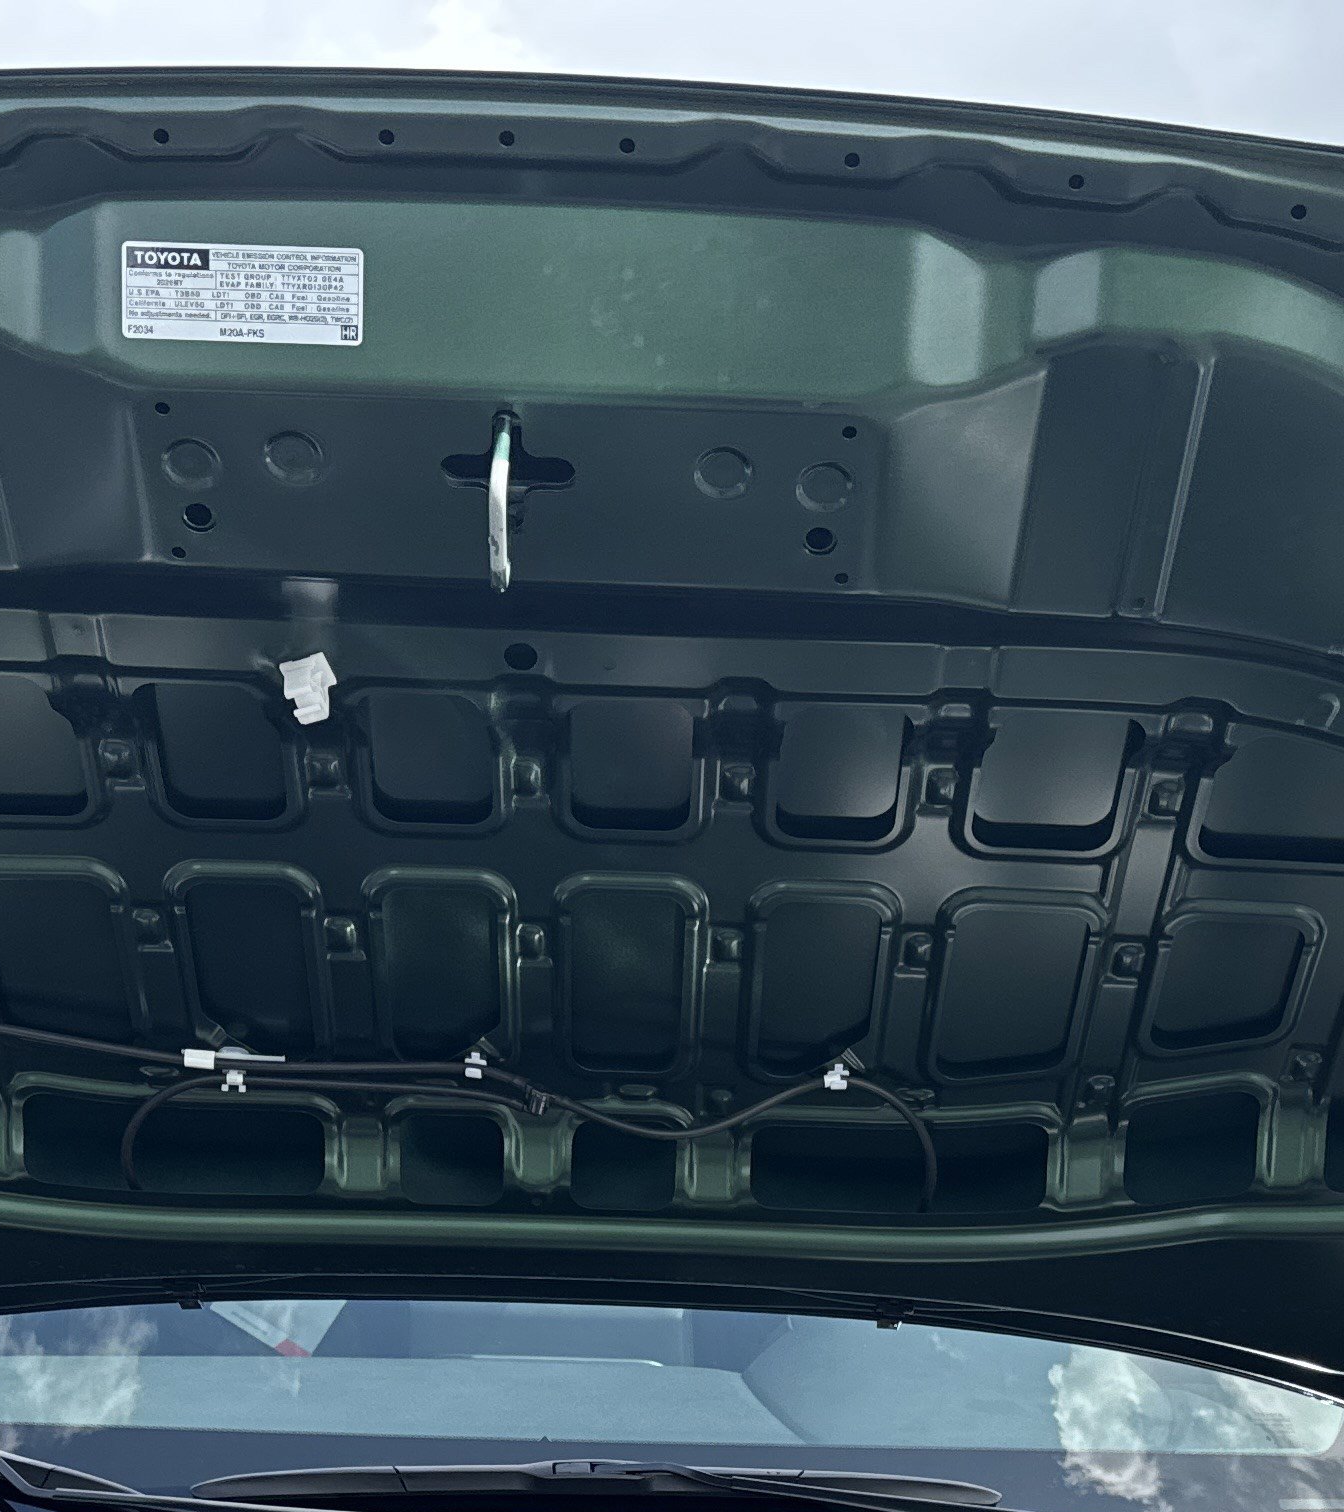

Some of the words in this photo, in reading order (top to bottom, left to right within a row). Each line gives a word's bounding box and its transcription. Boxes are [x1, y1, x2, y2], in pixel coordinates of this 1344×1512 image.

[134, 251, 202, 266] TOYOTA
[242, 252, 274, 260] EMISSION
[277, 253, 308, 261] CONTROL
[311, 254, 357, 262] INFORMATION
[227, 262, 256, 270] TOYOTA
[287, 264, 342, 272] CORPORATION
[128, 270, 162, 278] Conforms
[128, 299, 166, 307] California
[316, 305, 350, 313] Gasoline
[127, 324, 153, 334] F2034
[220, 328, 264, 338] M20A-FKS
[342, 326, 357, 340] HR
